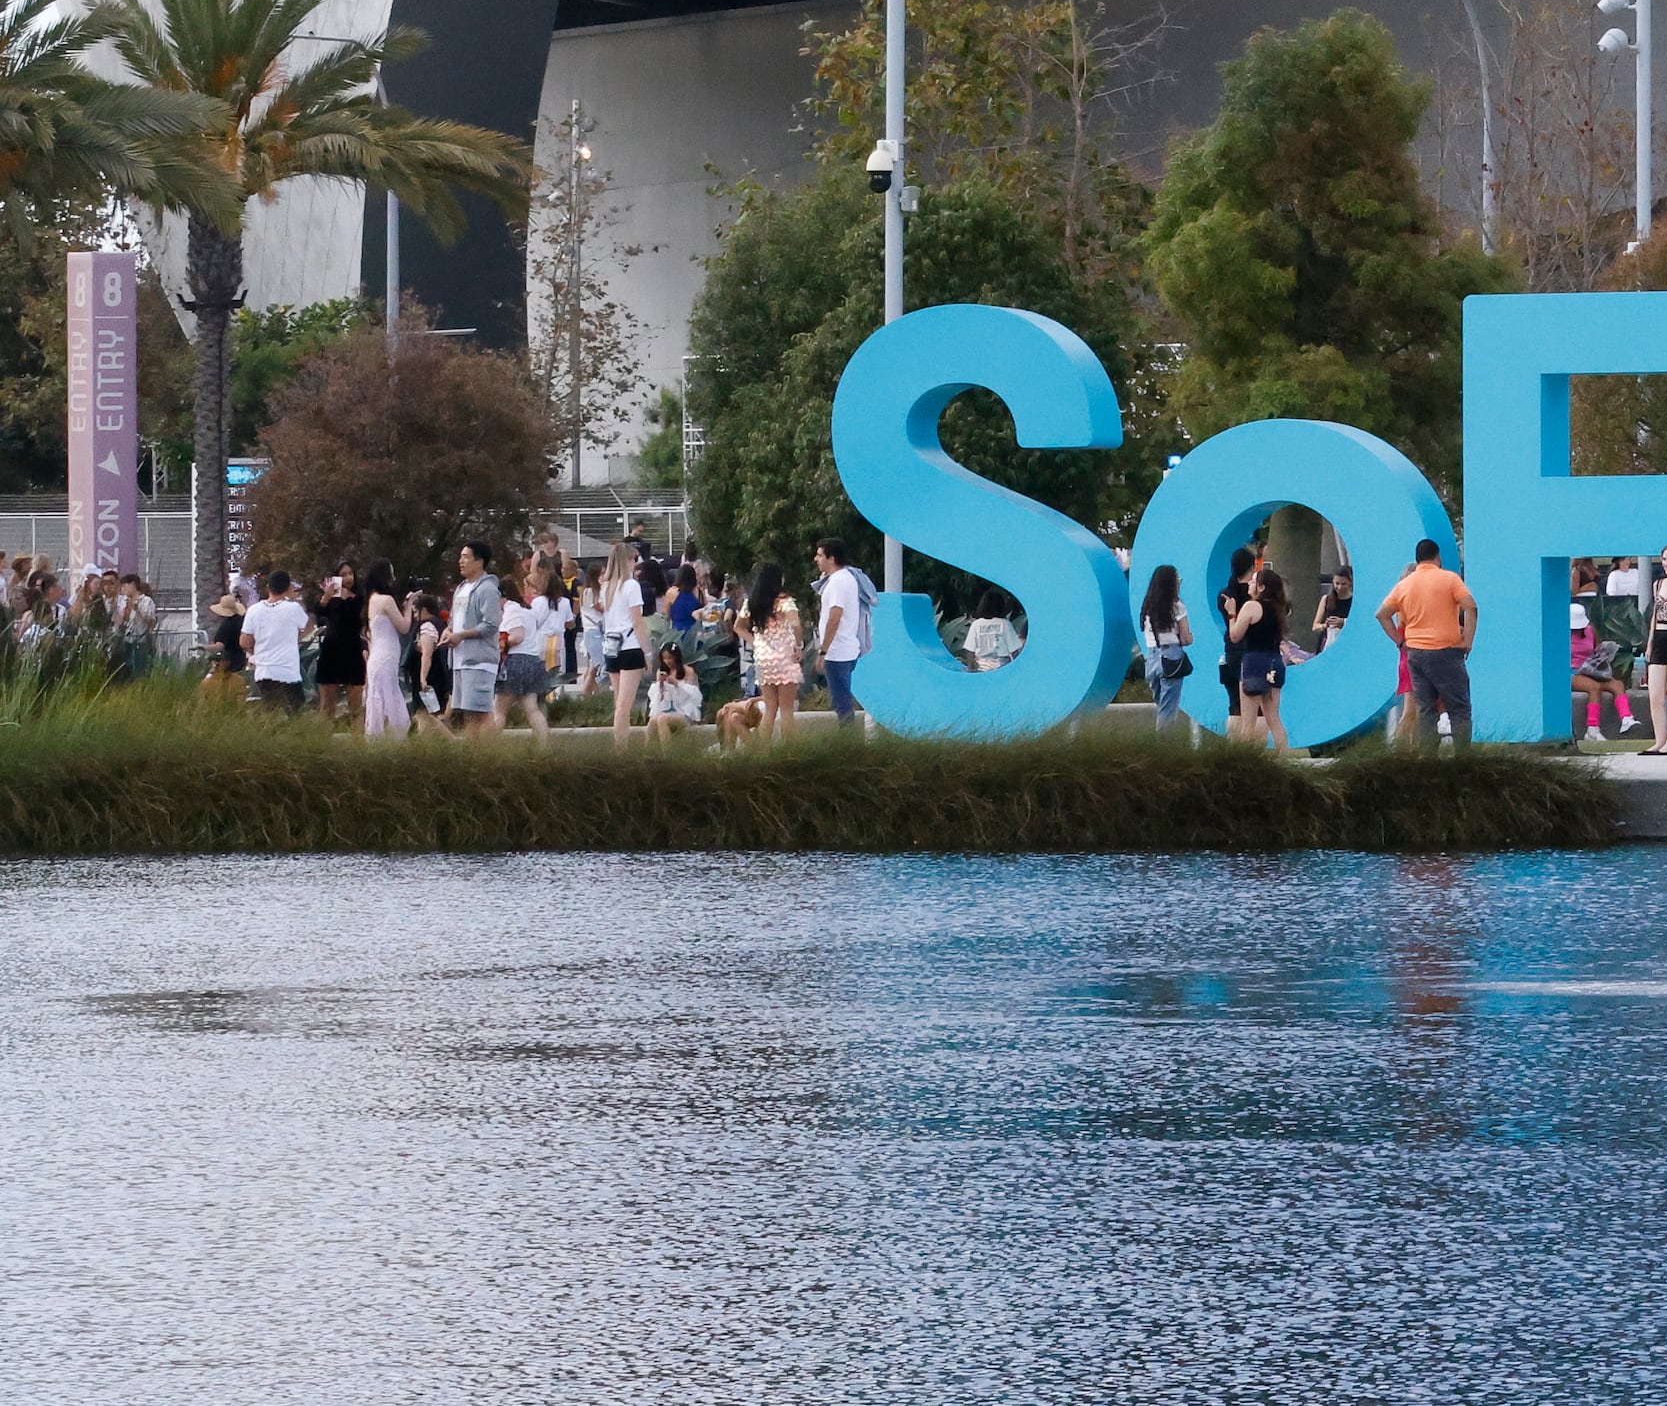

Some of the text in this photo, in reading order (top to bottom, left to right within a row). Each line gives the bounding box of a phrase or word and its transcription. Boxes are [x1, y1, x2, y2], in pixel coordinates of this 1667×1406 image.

[75, 272, 87, 308] 8
[103, 271, 122, 307] 8
[71, 332, 88, 432] ENTRY
[96, 329, 125, 432] ENTRY
